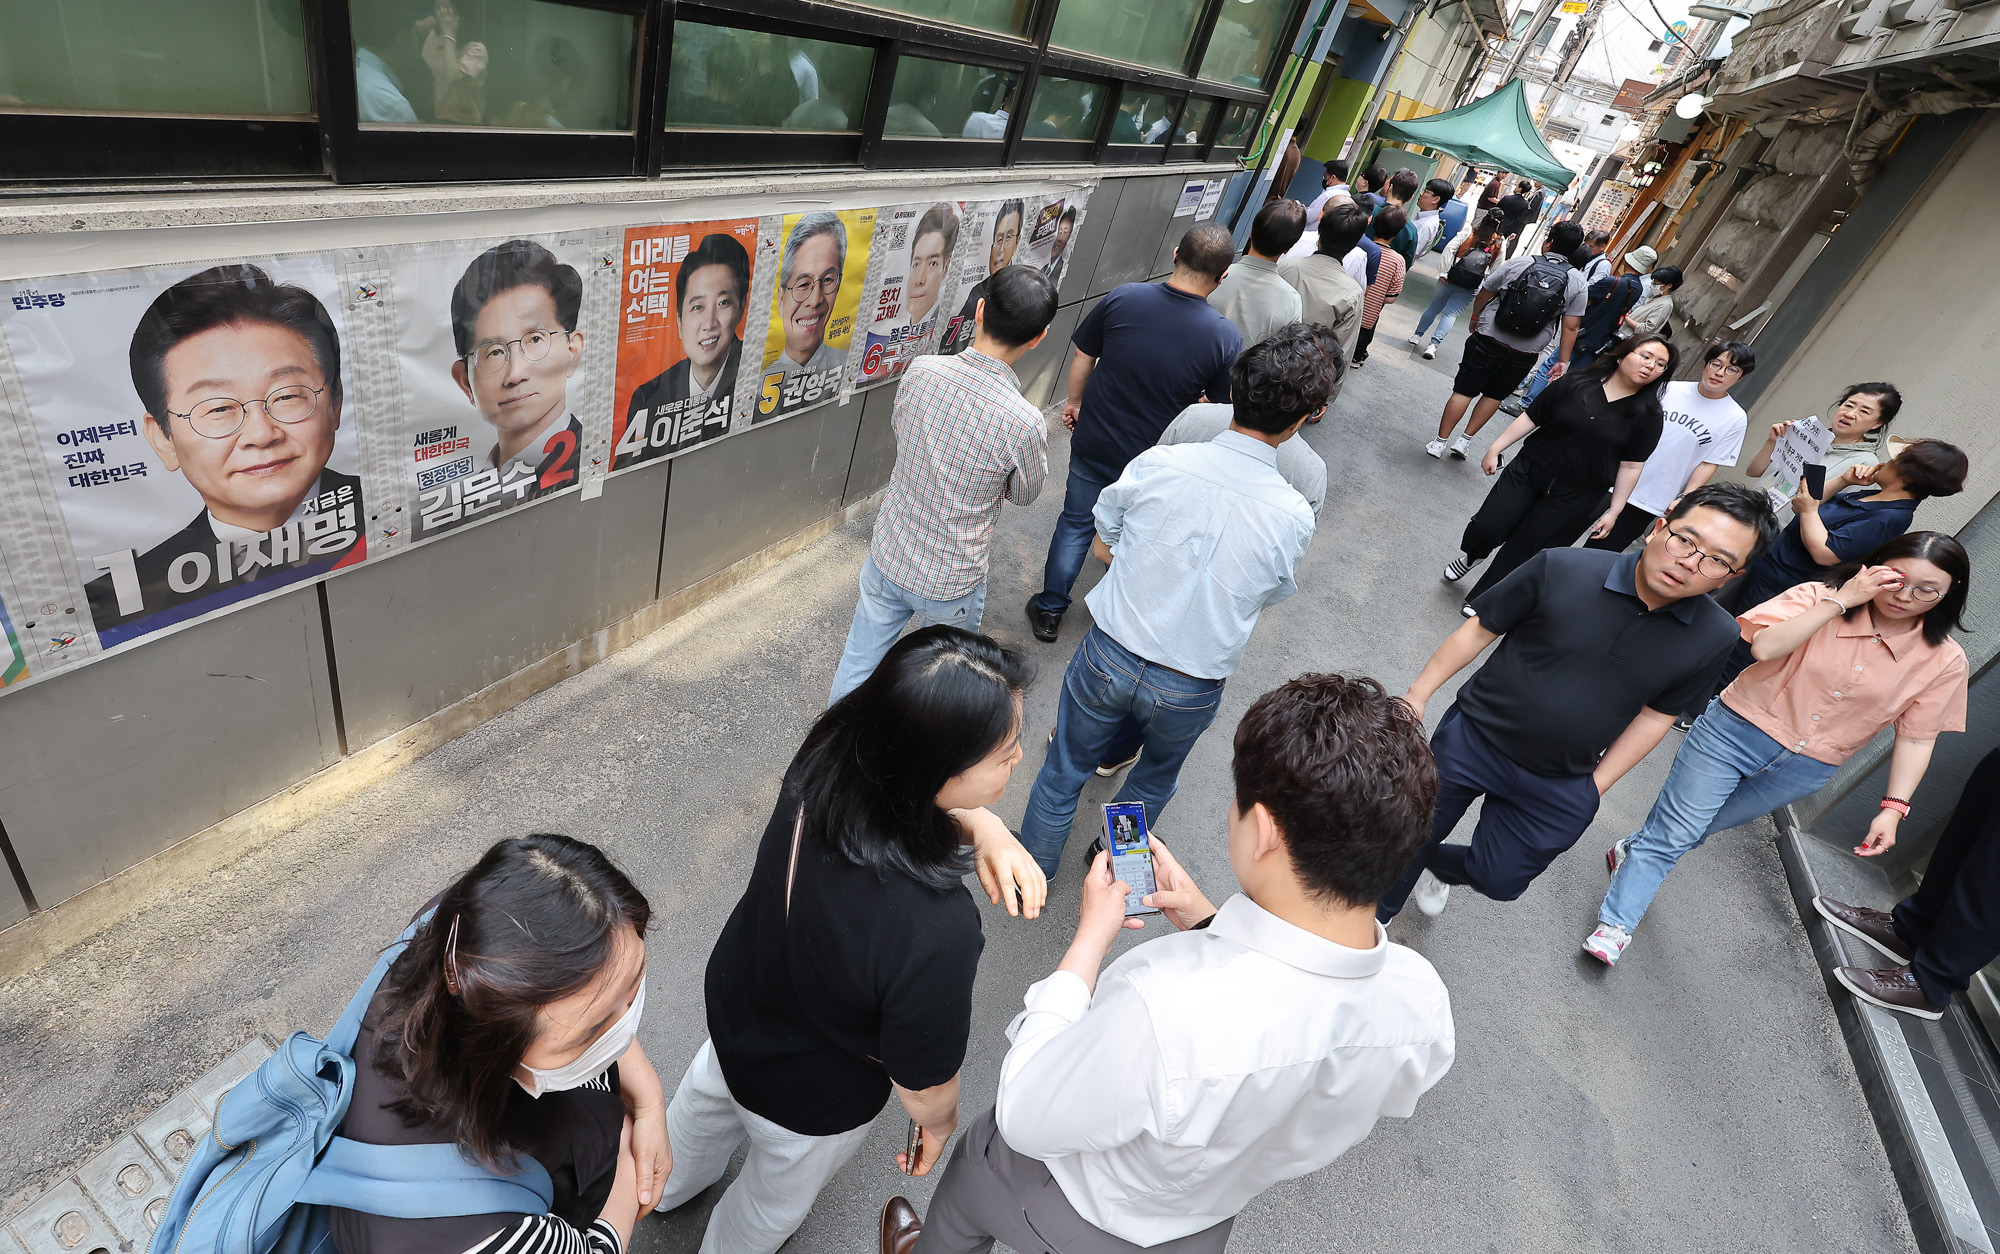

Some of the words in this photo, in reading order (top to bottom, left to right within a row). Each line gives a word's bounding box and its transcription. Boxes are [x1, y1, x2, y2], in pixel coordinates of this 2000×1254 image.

[630, 234, 690, 266] 미래를
[18, 289, 39, 297] 더불어
[628, 267, 670, 294] 여는
[879, 286, 901, 305] 정치
[12, 292, 66, 311] 민주당
[626, 292, 669, 324] 선택
[875, 304, 901, 322] 교체!
[890, 325, 910, 342] 젊은
[947, 315, 964, 346] 7
[862, 343, 884, 377] 6
[655, 399, 684, 417] 새로운
[684, 390, 710, 409] 대통령
[758, 370, 786, 415] 5
[782, 364, 843, 408] 권영국
[56, 419, 138, 447] 이제부터
[414, 425, 457, 448] 새롭게
[614, 408, 649, 458] 4
[650, 395, 730, 448] 이준석
[1663, 410, 1712, 446] ROOKLYN
[63, 448, 106, 470] 진짜
[414, 437, 470, 463] 대한민국
[68, 461, 148, 488] 대한민국
[419, 460, 538, 532] 김문수
[539, 429, 577, 490] 2
[420, 459, 471, 487] 정정당당
[302, 484, 354, 515] 지금은
[92, 548, 145, 617] 1
[167, 502, 358, 594] 이재명
[1881, 1026, 1904, 1058] STEP
[1893, 1056, 1919, 1093] YOUR
[1907, 1091, 1939, 1143] WATCH
[1934, 1161, 1972, 1222] 계단주의
